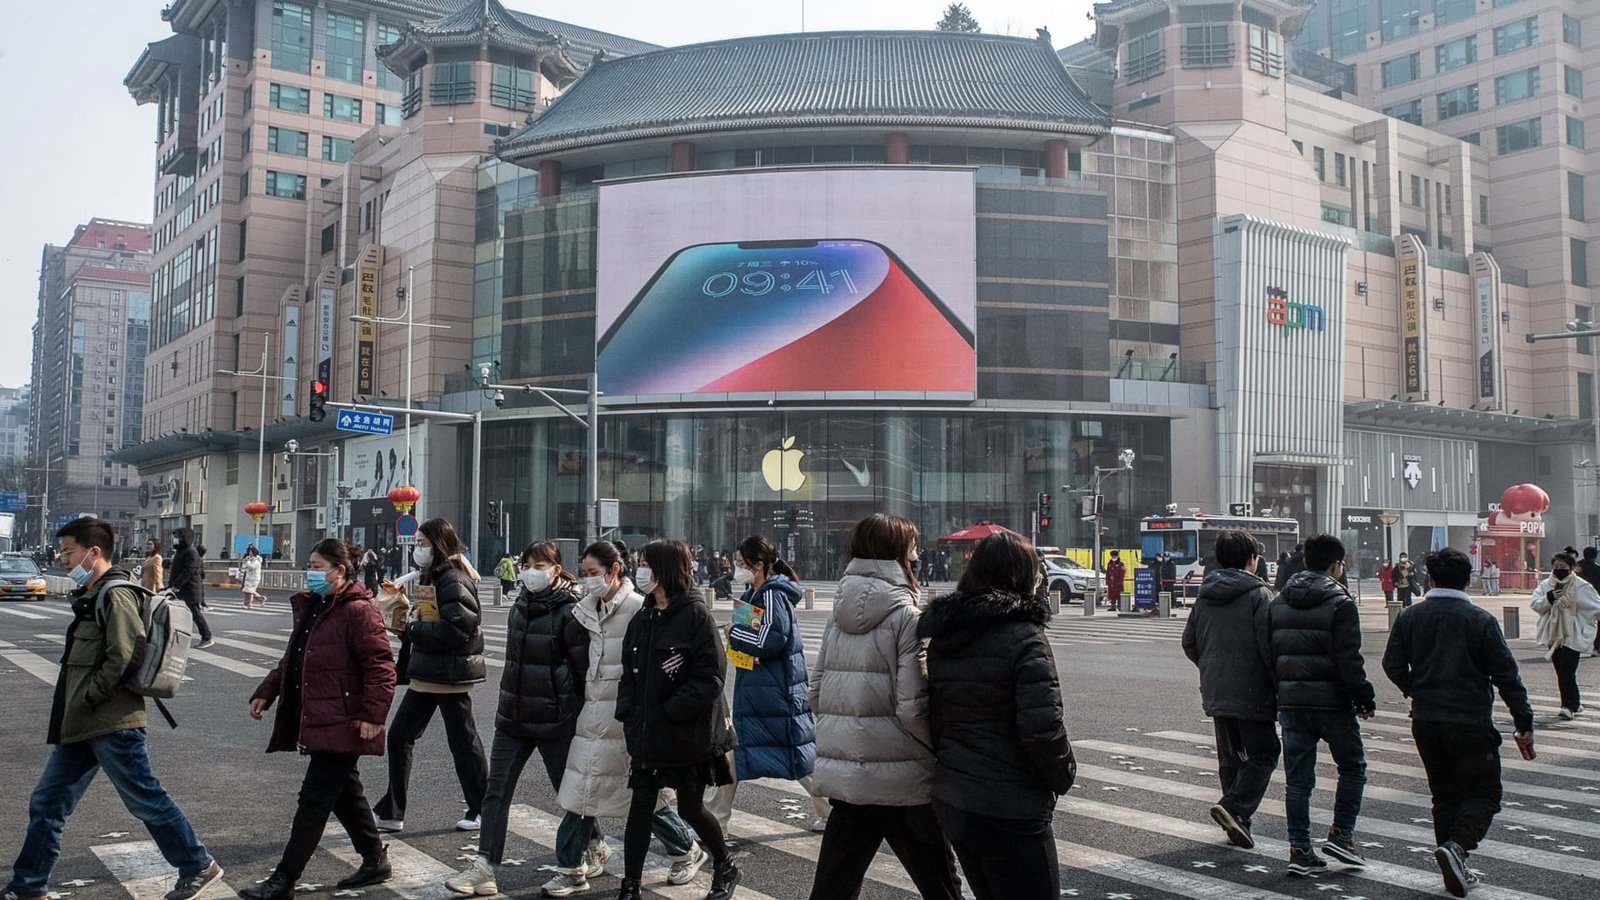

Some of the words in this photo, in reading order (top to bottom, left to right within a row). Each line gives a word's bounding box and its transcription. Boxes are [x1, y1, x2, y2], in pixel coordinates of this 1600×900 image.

[795, 259, 819, 267] 10%
[702, 269, 859, 298] 09:41
[1267, 298, 1325, 337] apm
[1407, 343, 1418, 387] 就在6楼
